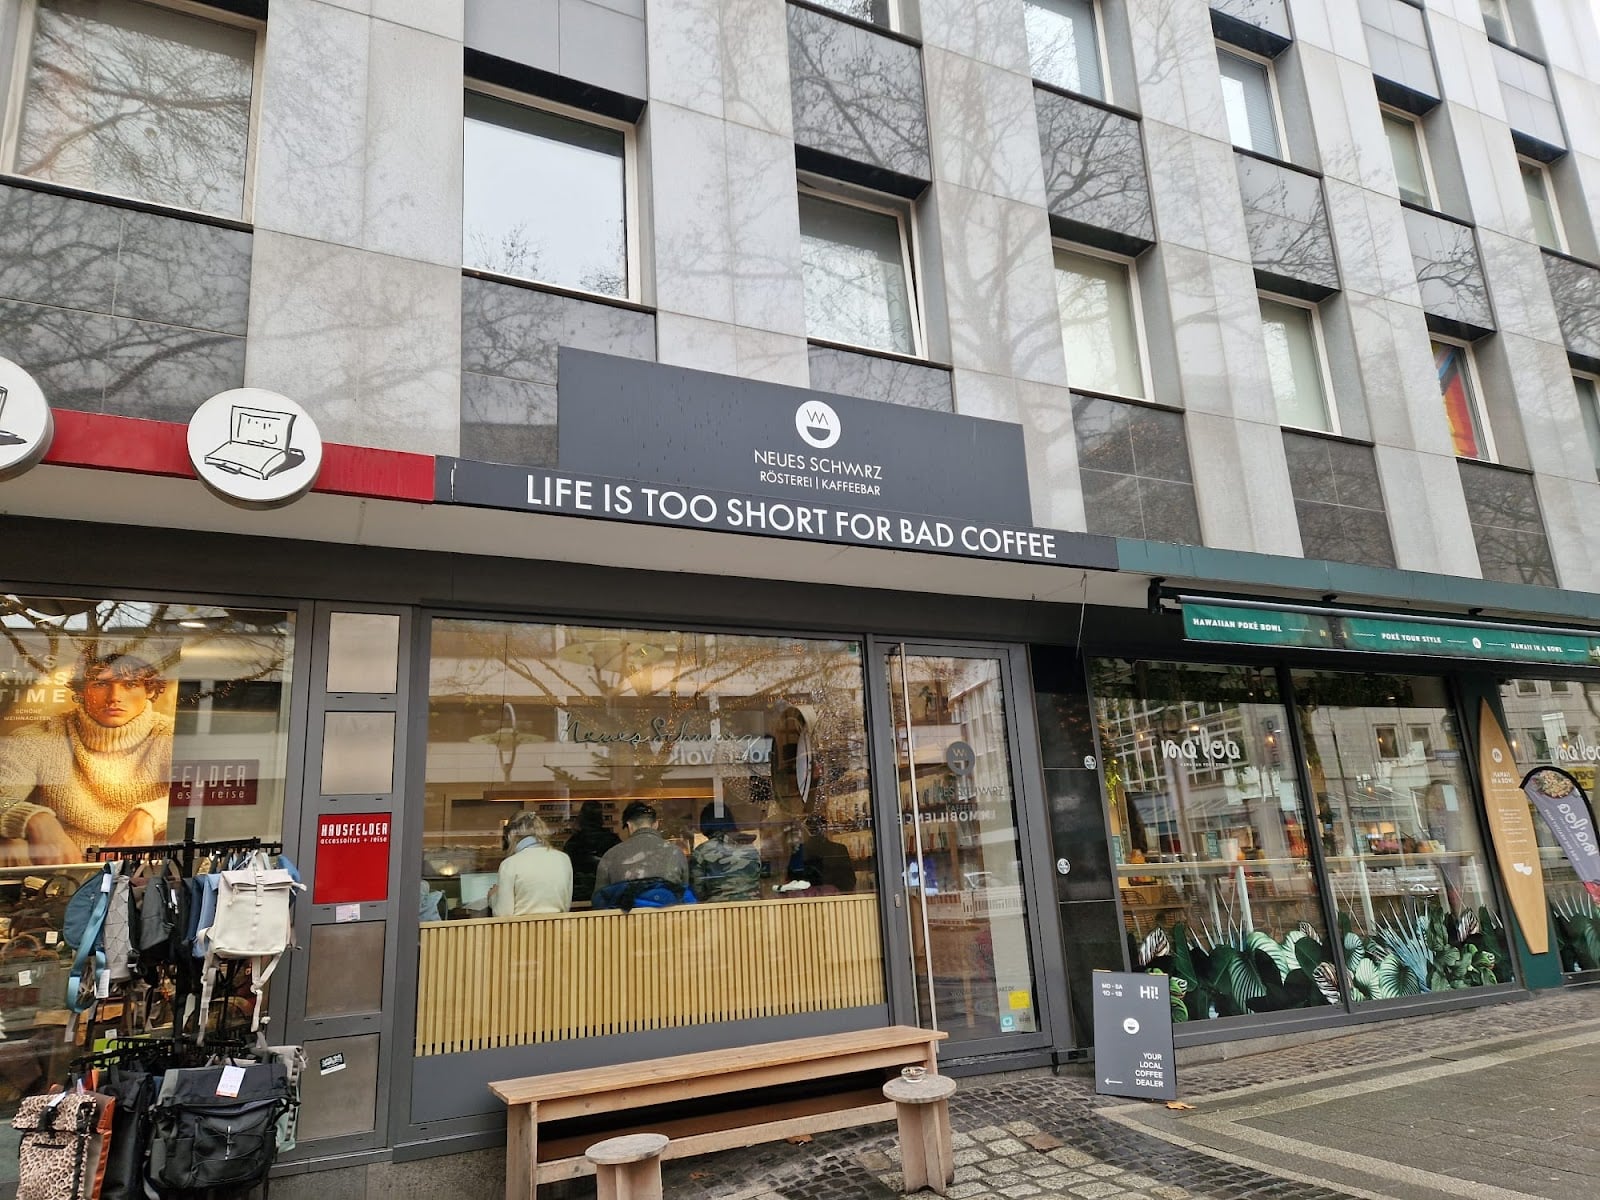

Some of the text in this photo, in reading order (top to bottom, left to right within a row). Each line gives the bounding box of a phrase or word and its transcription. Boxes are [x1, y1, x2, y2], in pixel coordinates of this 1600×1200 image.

[754, 449, 883, 480] NEUES SCHWARZ
[760, 470, 813, 488] RÖSTEREI
[821, 479, 881, 496] KAFFEEBAR
[527, 474, 1057, 559] LIFE IS TOO SHORT FOR BAD COFFEE
[1193, 618, 1236, 628] HAWAIIAN
[1260, 623, 1283, 633] BOWL
[1401, 634, 1421, 642] YOUR
[1422, 635, 1442, 644] STYLE
[1511, 642, 1533, 651] HAWAII
[211, 788, 245, 799] reise
[320, 823, 389, 837] HAUSFELDER
[320, 837, 361, 845] accessoires
[1140, 985, 1159, 1000] Hi!
[1143, 1052, 1163, 1061] YOUR
[1139, 1061, 1163, 1070] LOCAL
[1135, 1070, 1164, 1079] COFFEE
[1135, 1079, 1164, 1088] DEALER
